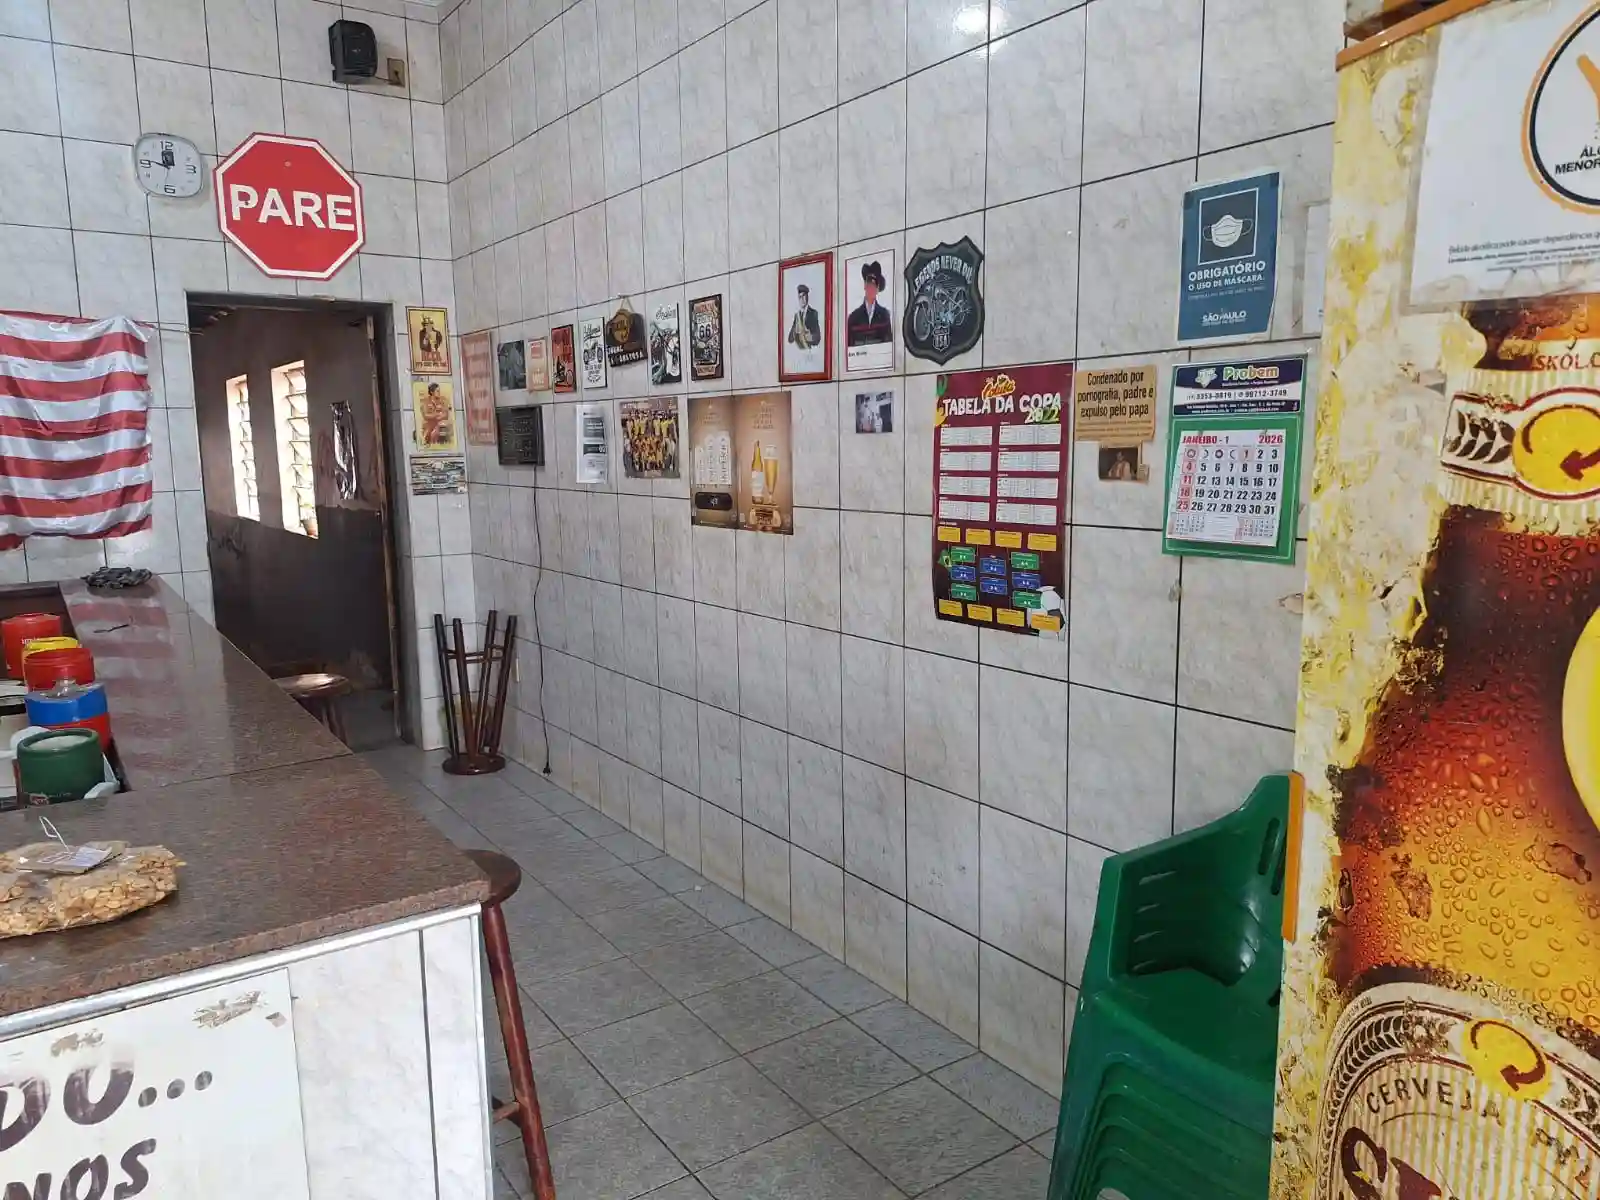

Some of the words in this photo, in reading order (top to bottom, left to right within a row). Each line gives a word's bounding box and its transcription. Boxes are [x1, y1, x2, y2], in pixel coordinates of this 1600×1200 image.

[160, 141, 173, 151] 12
[185, 165, 197, 174] 3
[164, 184, 176, 194] 6
[229, 183, 355, 232] PARE
[1188, 260, 1266, 282] OBRIGATÓRIO
[1196, 281, 1212, 290] USO
[1213, 279, 1222, 288] DE
[1202, 312, 1219, 322] SÃO
[700, 323, 711, 339] 66
[1087, 370, 1128, 386] Condenado
[1130, 371, 1144, 385] por
[1222, 365, 1279, 381] Probem
[1077, 387, 1120, 404] pornografia,
[1123, 386, 1147, 401] padre
[1148, 387, 1154, 398] e
[942, 396, 992, 416] TABELA
[995, 395, 1014, 413] DA
[1020, 391, 1061, 413] COPA
[1024, 405, 1060, 424] 2022
[1080, 404, 1108, 420] expulso
[1109, 403, 1127, 419] pelo
[1129, 403, 1149, 418] papa
[1182, 435, 1217, 444] JANEIRO
[1224, 436, 1229, 444] 1
[1258, 434, 1283, 444] 2026
[1244, 450, 1248, 458] 1
[1257, 449, 1264, 459] 2
[1271, 449, 1278, 459] 3
[1186, 462, 1192, 471] 4
[1200, 463, 1207, 472] 5
[1214, 463, 1220, 472] 6
[1229, 463, 1234, 472] 7
[1242, 463, 1248, 472] 8
[1256, 463, 1262, 472] 9
[1269, 463, 1279, 473] 10
[1184, 475, 1192, 484] 11
[1197, 475, 1206, 485] 12
[1211, 476, 1220, 486] 13
[1225, 476, 1235, 486] 14
[1239, 476, 1249, 486] 15
[1253, 477, 1263, 487] 16
[1267, 478, 1277, 487] 17
[1180, 488, 1190, 497] 18
[1195, 488, 1205, 498] 19
[1208, 489, 1220, 499] 20
[1223, 490, 1234, 499] 21
[1236, 490, 1248, 500] 22
[1250, 491, 1262, 500] 23
[1265, 491, 1277, 501] 24
[1177, 500, 1189, 510] 25
[1191, 501, 1203, 511] 26
[1206, 503, 1217, 512] 27
[1220, 503, 1232, 513] 28
[1234, 504, 1246, 514] 29
[1248, 505, 1261, 515] 30
[1263, 505, 1275, 515] 31
